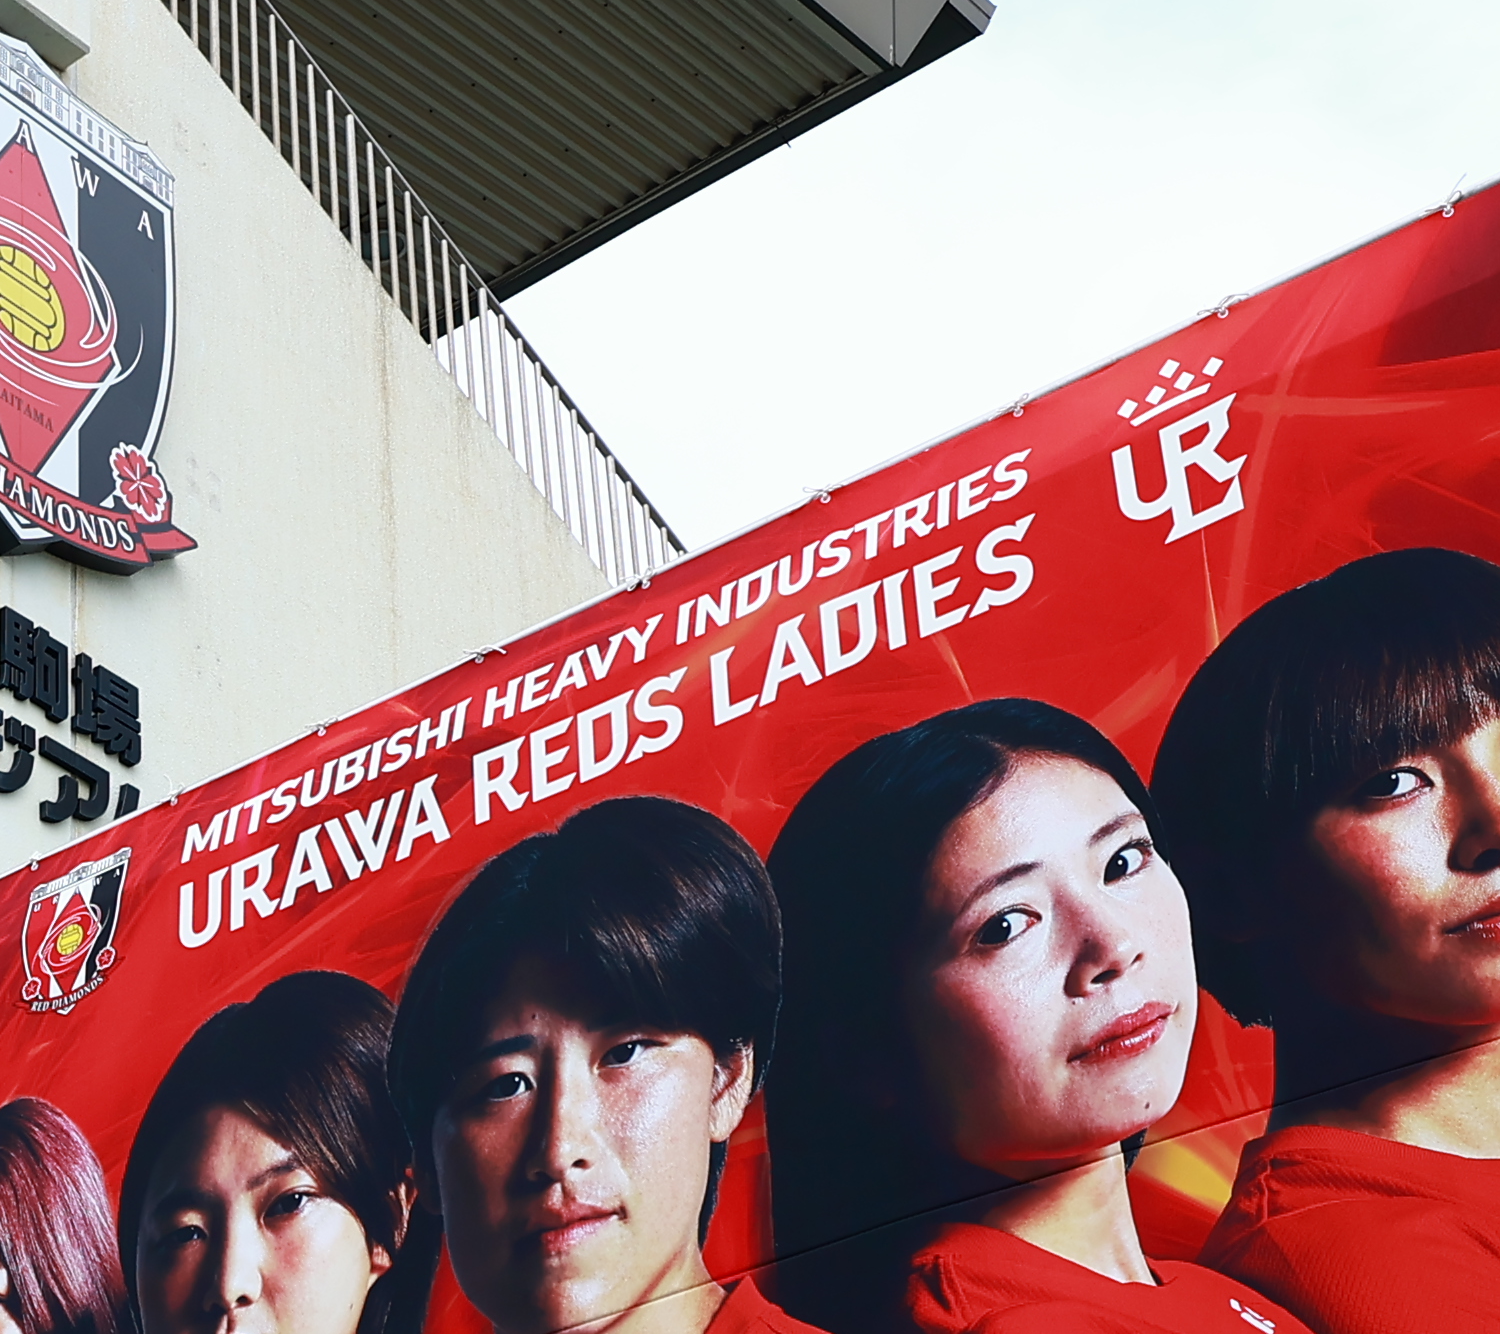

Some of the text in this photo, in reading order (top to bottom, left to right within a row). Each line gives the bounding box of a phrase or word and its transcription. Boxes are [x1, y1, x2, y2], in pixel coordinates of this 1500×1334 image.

[177, 513, 1036, 949] URAWA REDS LADIES
[179, 448, 1033, 864] MITSUBISHI HEAVY INDUSTRIES
[31, 976, 104, 1012] RED DIAMONDS
